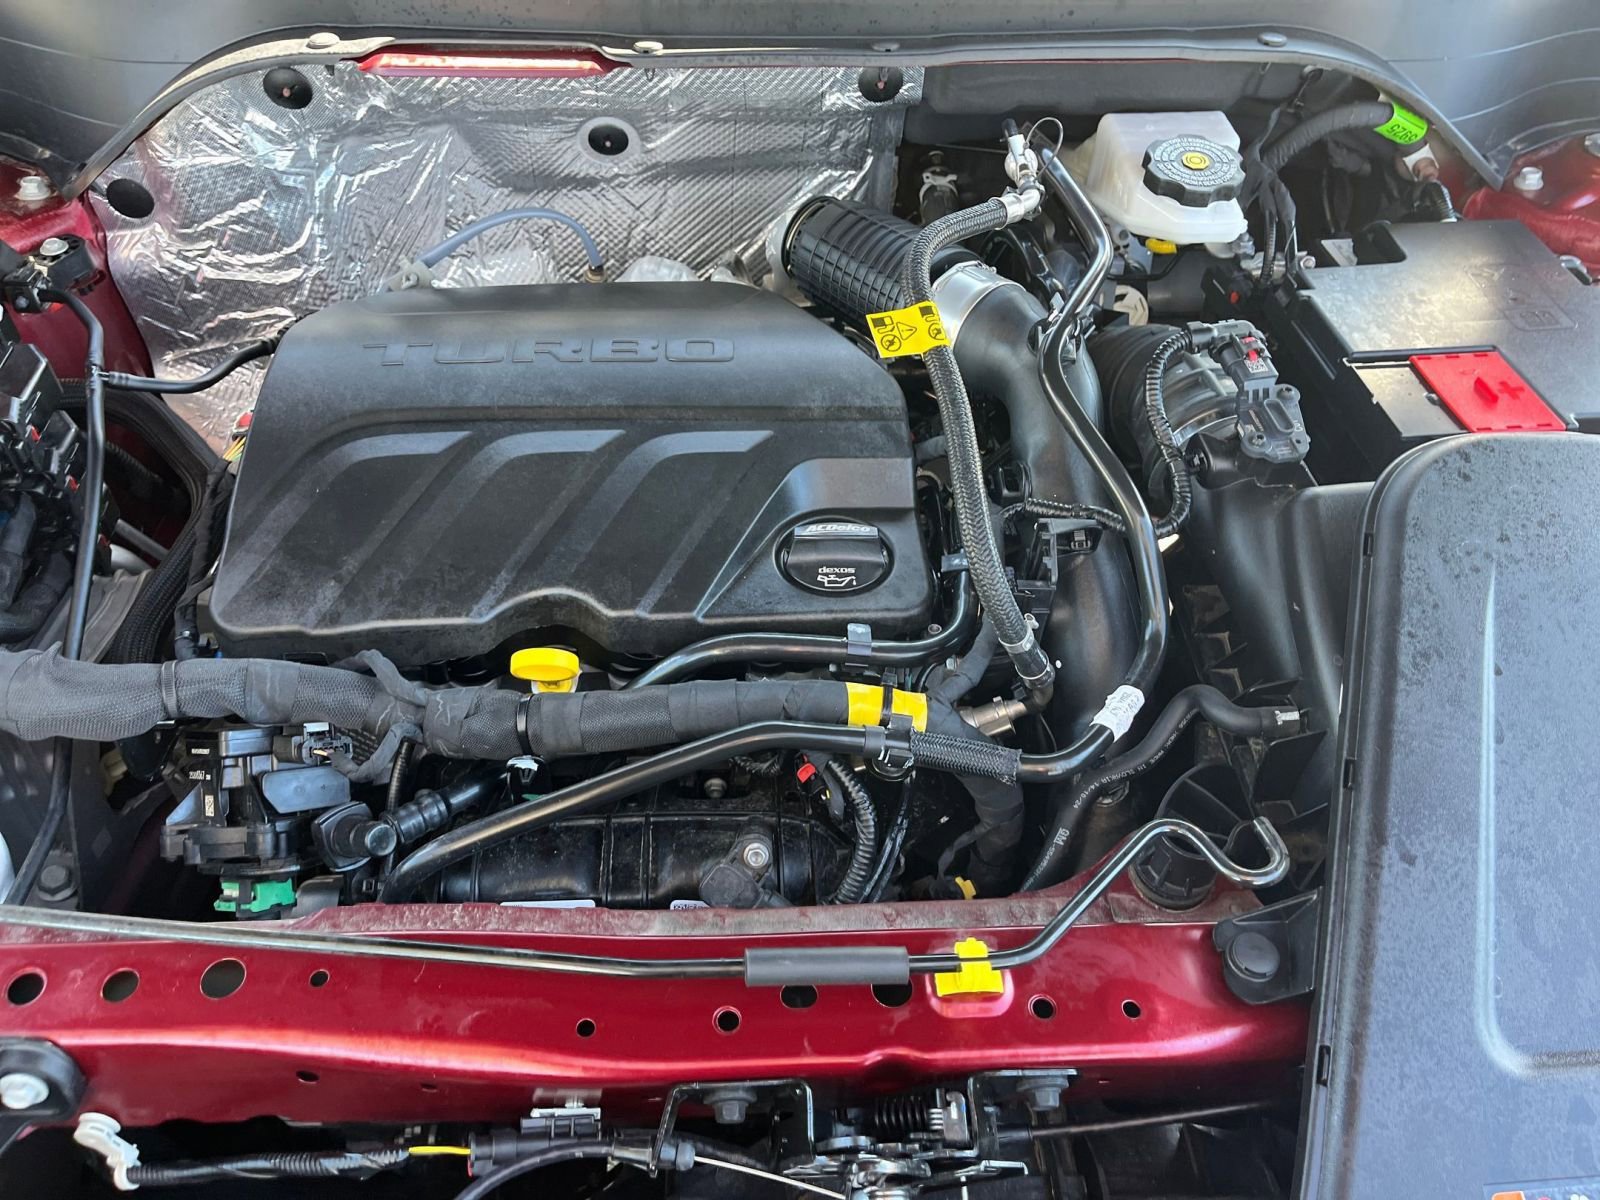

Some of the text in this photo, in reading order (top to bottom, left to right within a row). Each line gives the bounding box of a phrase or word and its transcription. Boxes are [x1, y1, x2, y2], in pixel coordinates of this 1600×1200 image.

[362, 338, 735, 366] TURBO
[805, 523, 871, 533] ACDelco
[818, 566, 856, 574] dexos
[1054, 827, 1070, 846] GM
